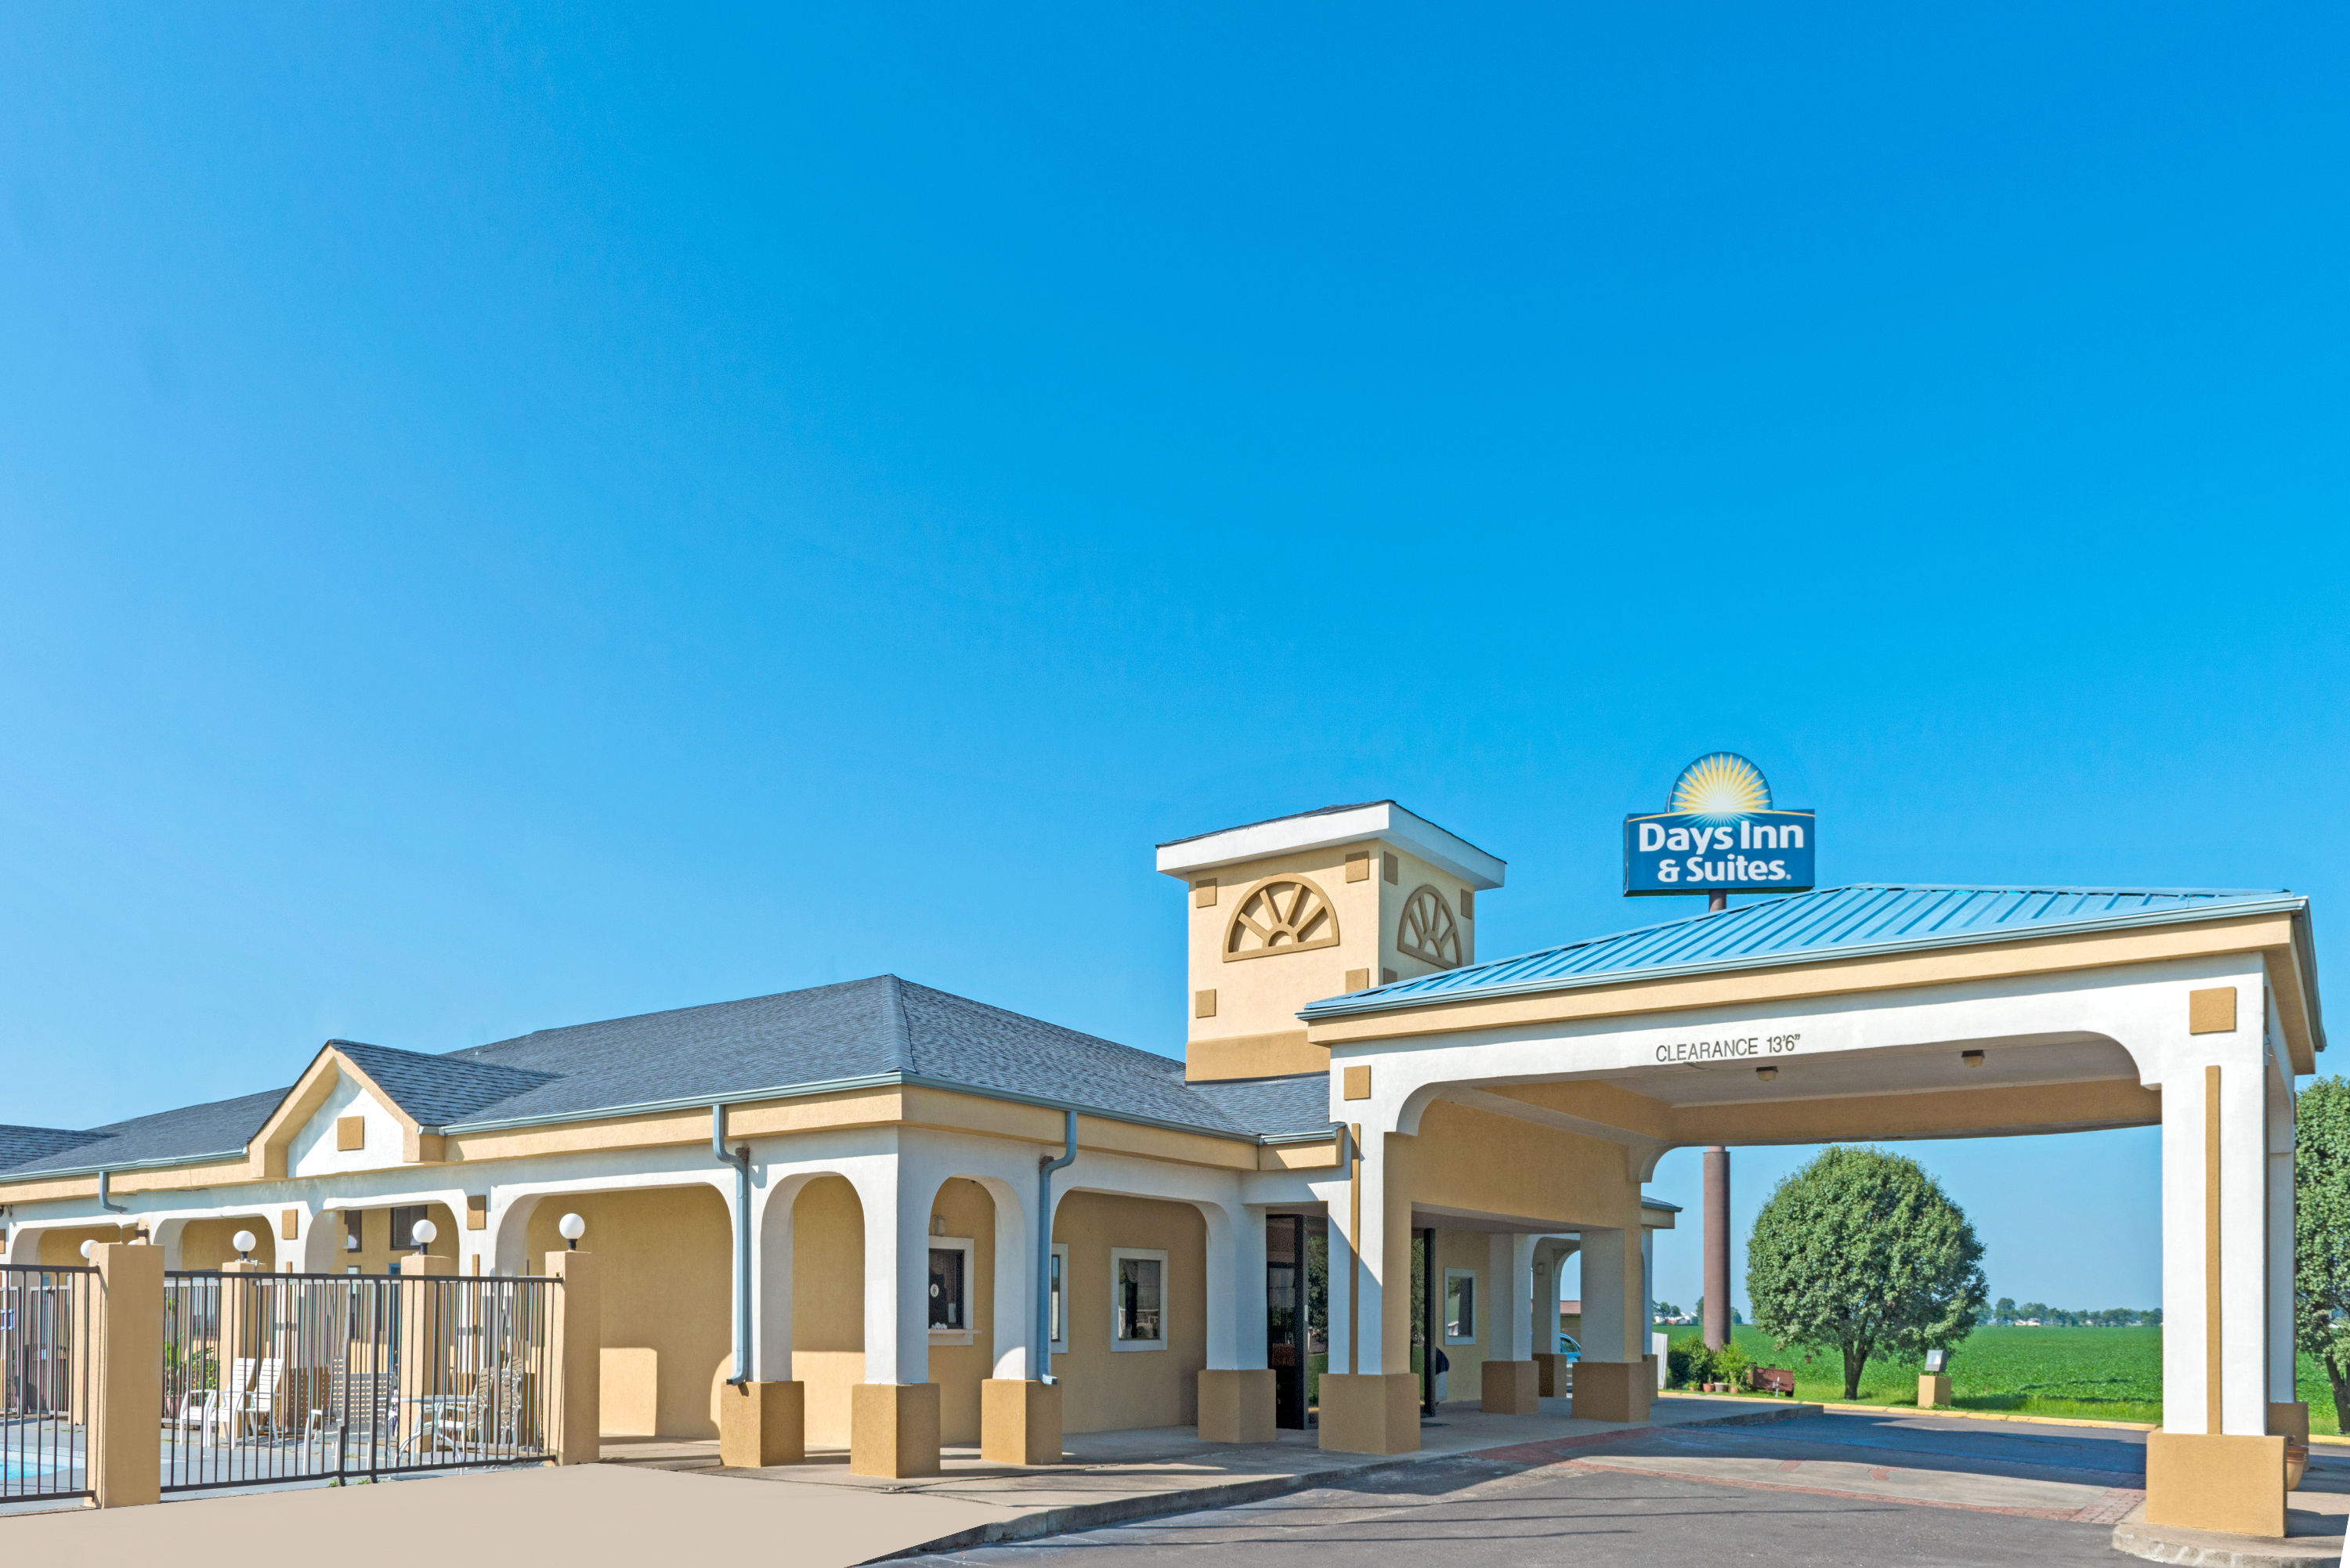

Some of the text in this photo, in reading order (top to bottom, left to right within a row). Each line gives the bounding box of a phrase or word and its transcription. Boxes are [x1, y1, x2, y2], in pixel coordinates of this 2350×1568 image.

[1640, 821, 1803, 854] Days Inn
[1658, 859, 1680, 883] &
[1656, 1038, 1759, 1062] CLEARANCE
